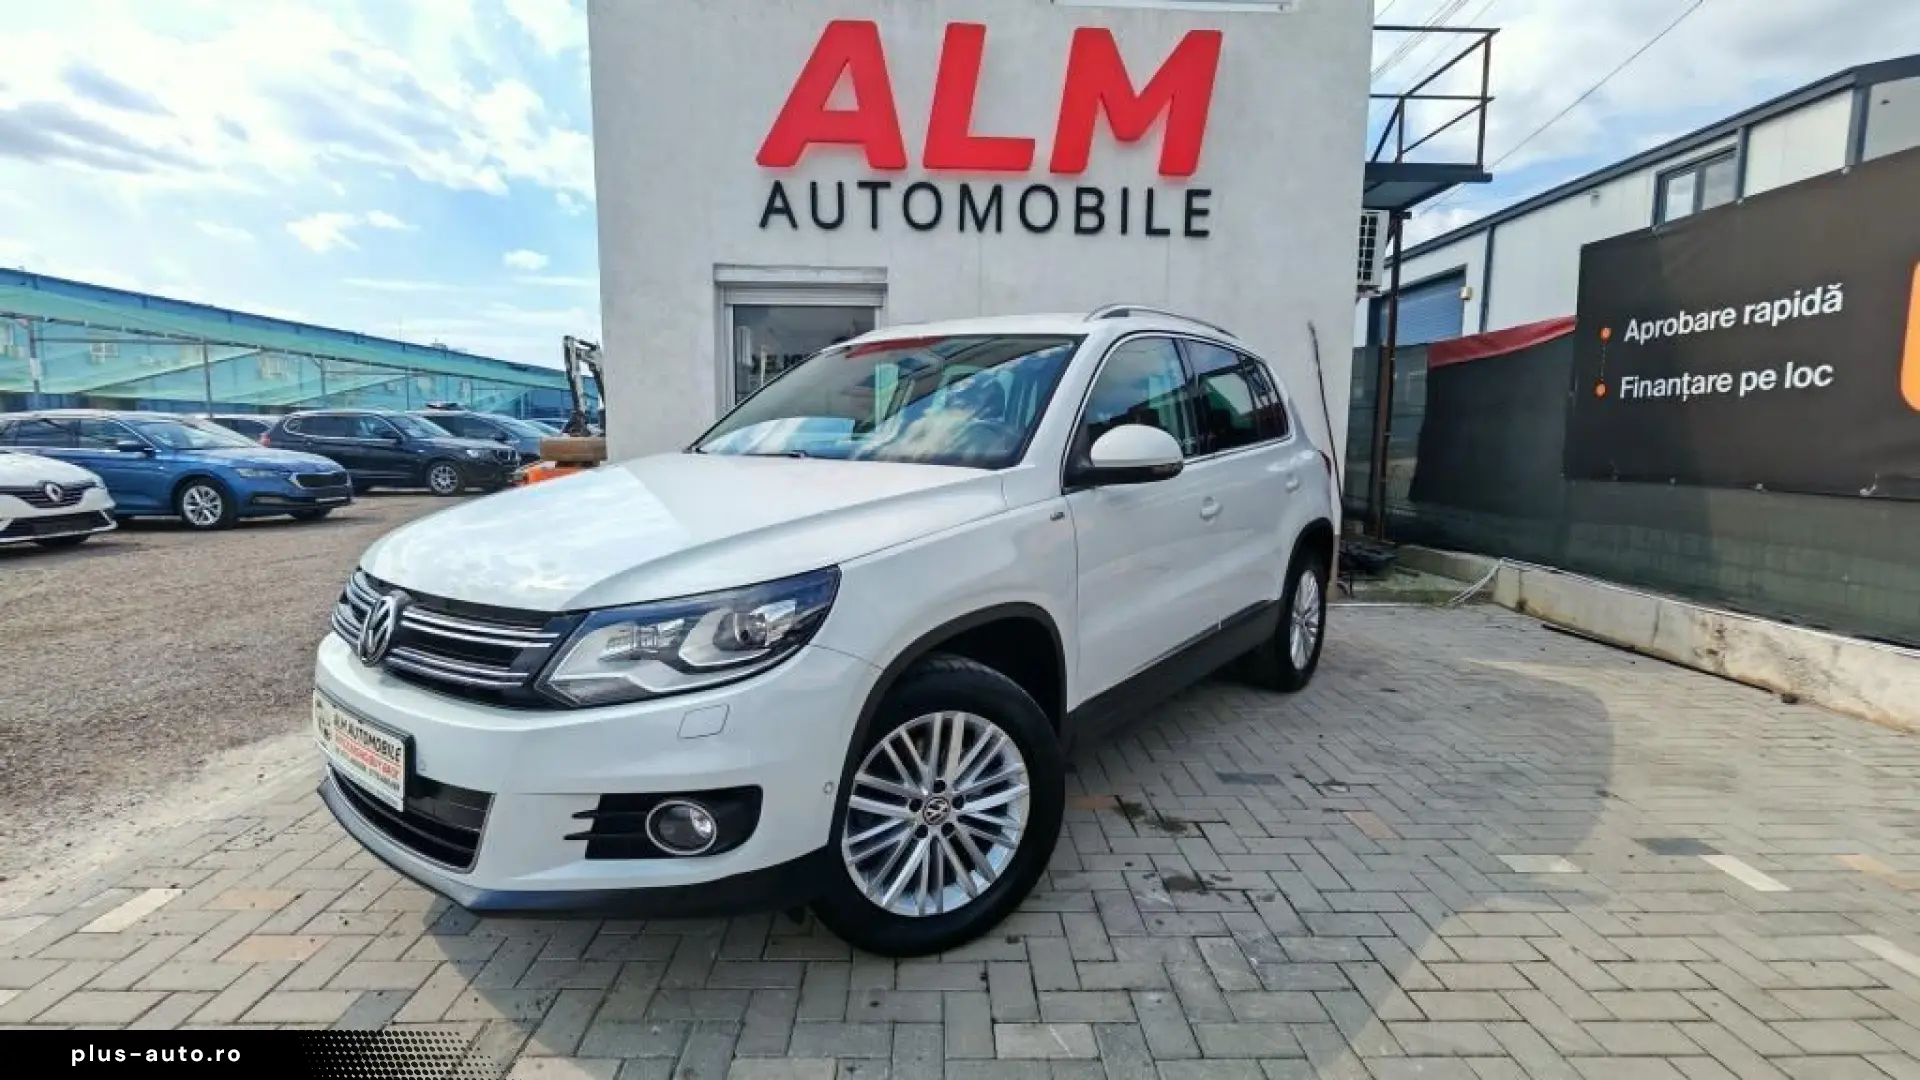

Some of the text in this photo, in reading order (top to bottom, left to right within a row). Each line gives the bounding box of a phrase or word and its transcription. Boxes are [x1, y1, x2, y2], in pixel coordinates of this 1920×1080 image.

[757, 19, 1223, 178] ALM
[758, 180, 1212, 238] AUTOMOBILE
[1623, 282, 1844, 346] Aprobare rapidă
[1619, 360, 1835, 402] Finanțare pe loc
